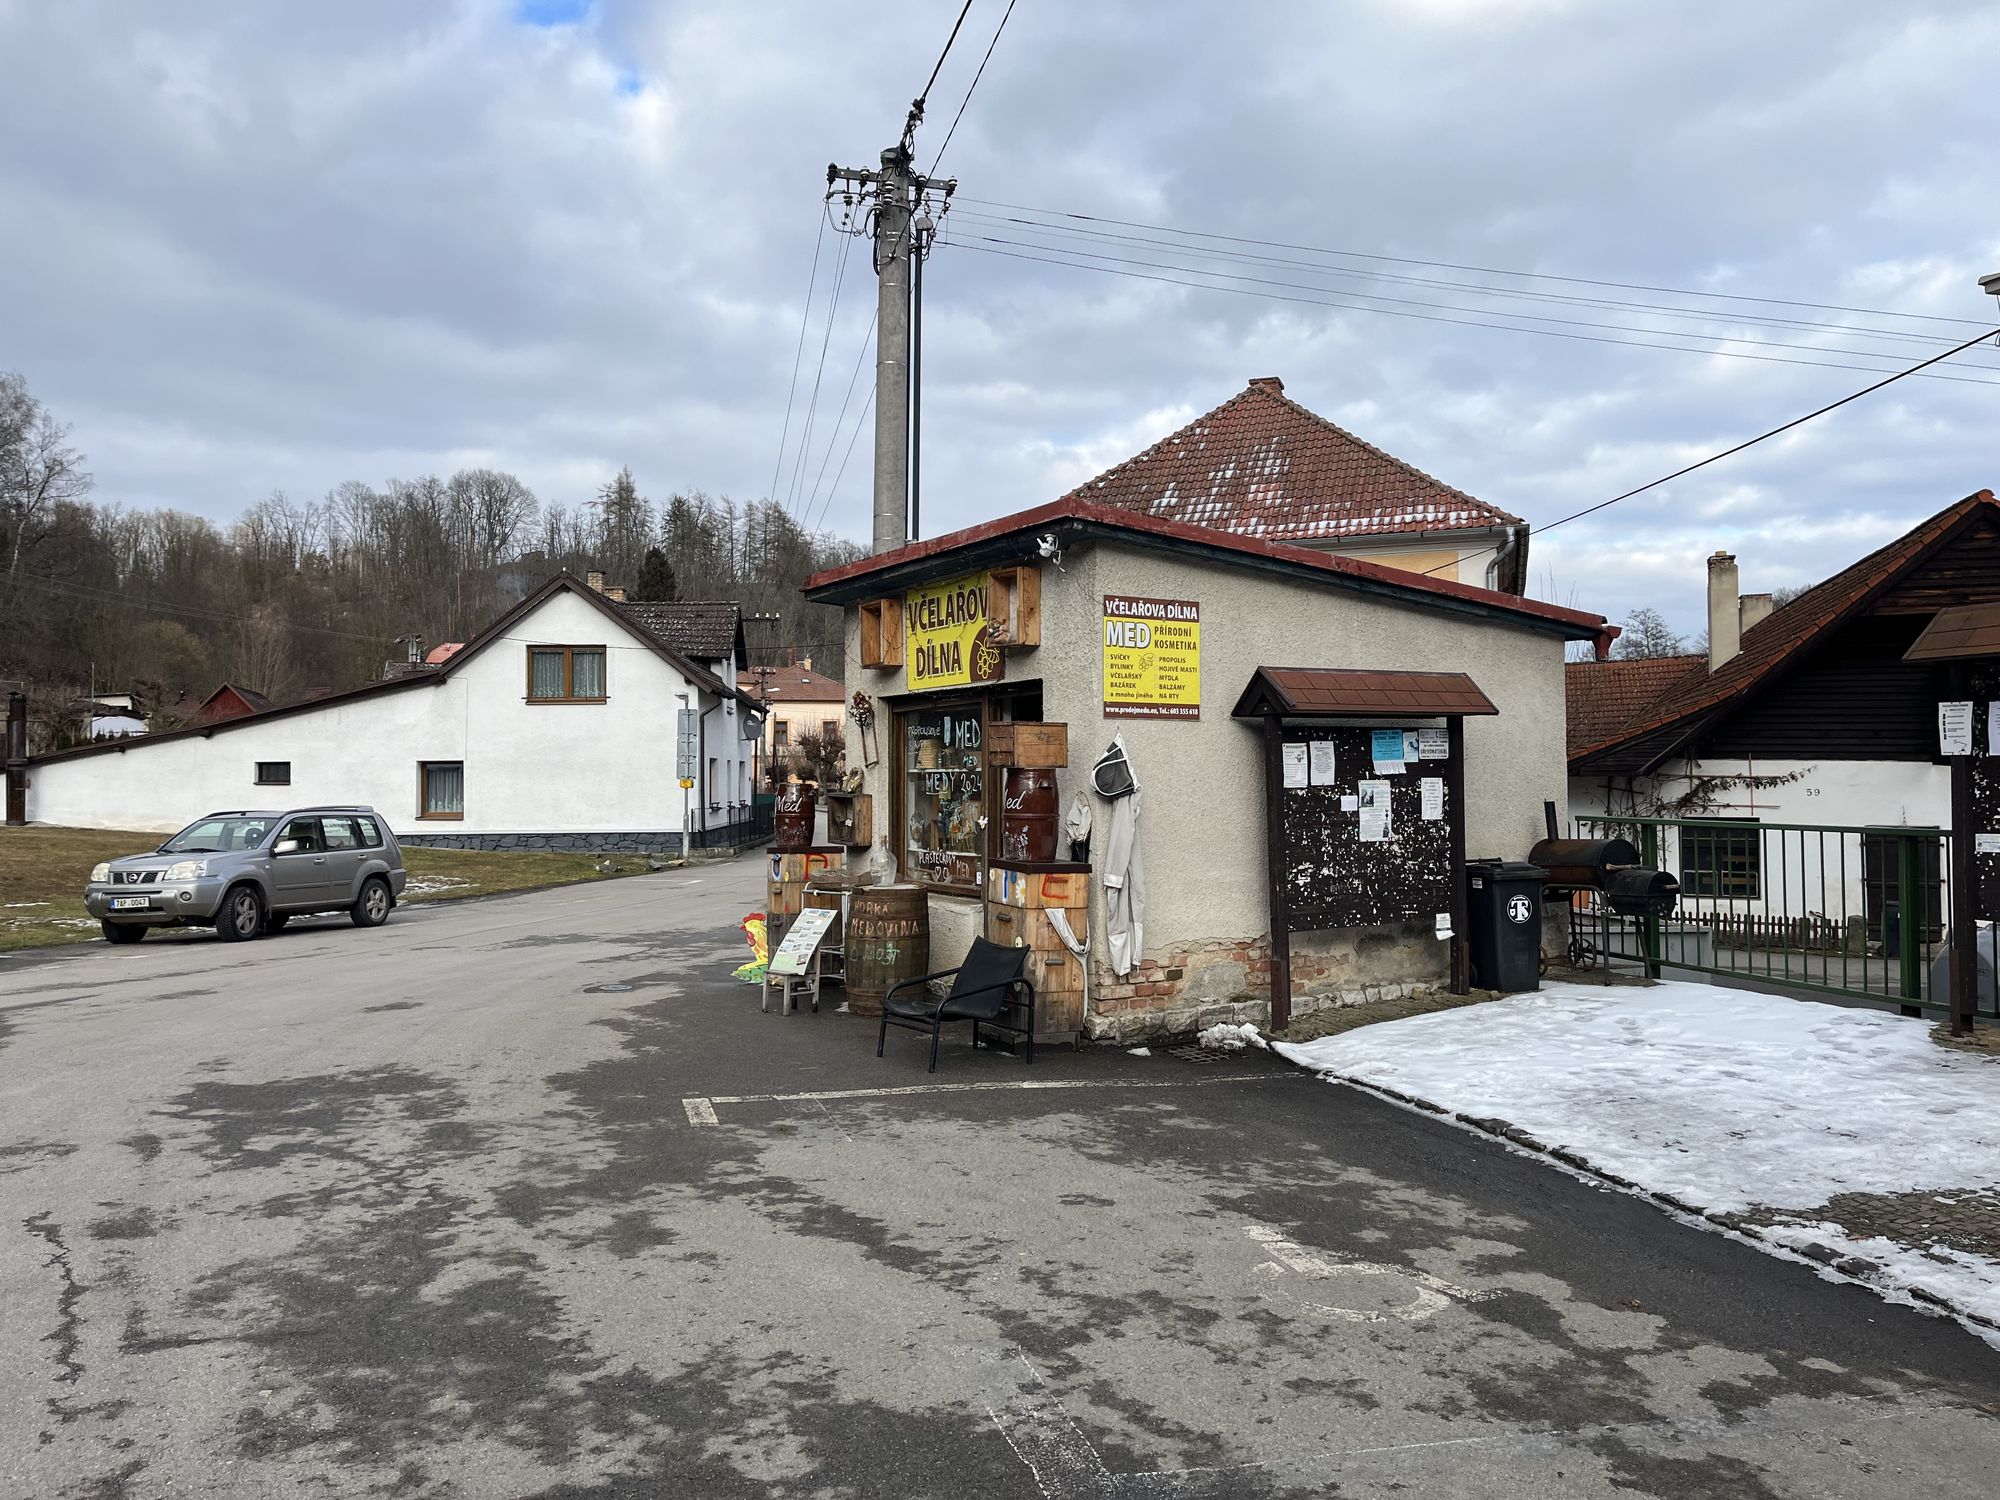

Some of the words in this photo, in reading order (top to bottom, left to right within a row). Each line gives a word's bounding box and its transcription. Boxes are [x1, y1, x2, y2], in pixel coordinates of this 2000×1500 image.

[908, 584, 988, 634] VČELAŘOV
[1105, 598, 1166, 618] VČELAŘOVA
[1167, 602, 1198, 620] DÍLNA
[1105, 620, 1152, 649] MED
[1154, 626, 1192, 637] PŘÍRODNÍ
[1154, 639, 1197, 651] KOSMETIKA
[915, 638, 963, 680] DÍLNA
[1110, 653, 1131, 661] SVÍČKY
[1159, 656, 1186, 664] PROPOLIS
[1159, 665, 1179, 673] HOJIVÉ
[1110, 672, 1143, 680] VČELAŘSKÝ
[1110, 681, 1137, 689] BAZÁREK
[1159, 683, 1186, 691] BALZÁMY
[1135, 692, 1154, 700] jiného
[955, 718, 981, 749] MED
[925, 771, 957, 793] MEDY
[960, 772, 982, 792] 2024
[1805, 788, 1821, 797] 59
[851, 918, 920, 938] MEDOVINA
